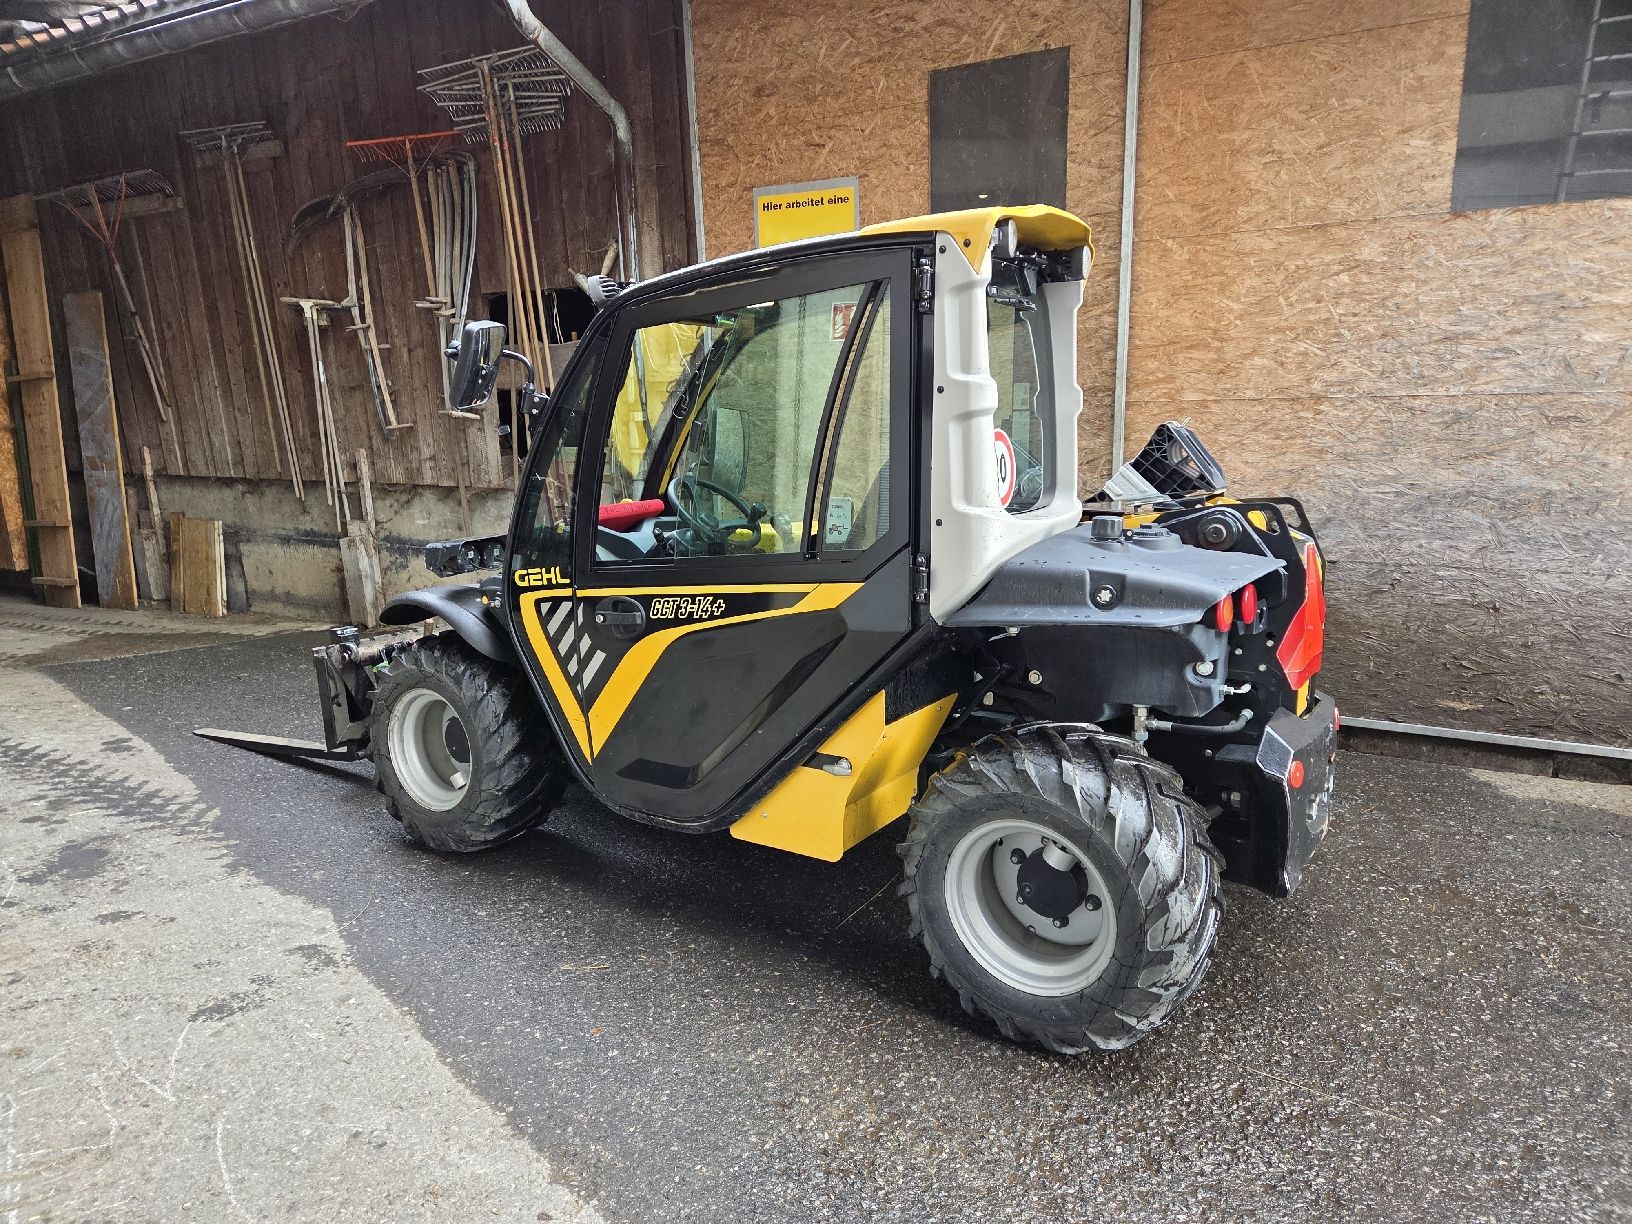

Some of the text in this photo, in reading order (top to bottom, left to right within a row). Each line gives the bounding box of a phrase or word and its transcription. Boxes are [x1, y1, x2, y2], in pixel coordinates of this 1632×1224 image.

[762, 194, 850, 212] Hier arbeitet eine
[514, 566, 571, 587] GEHL
